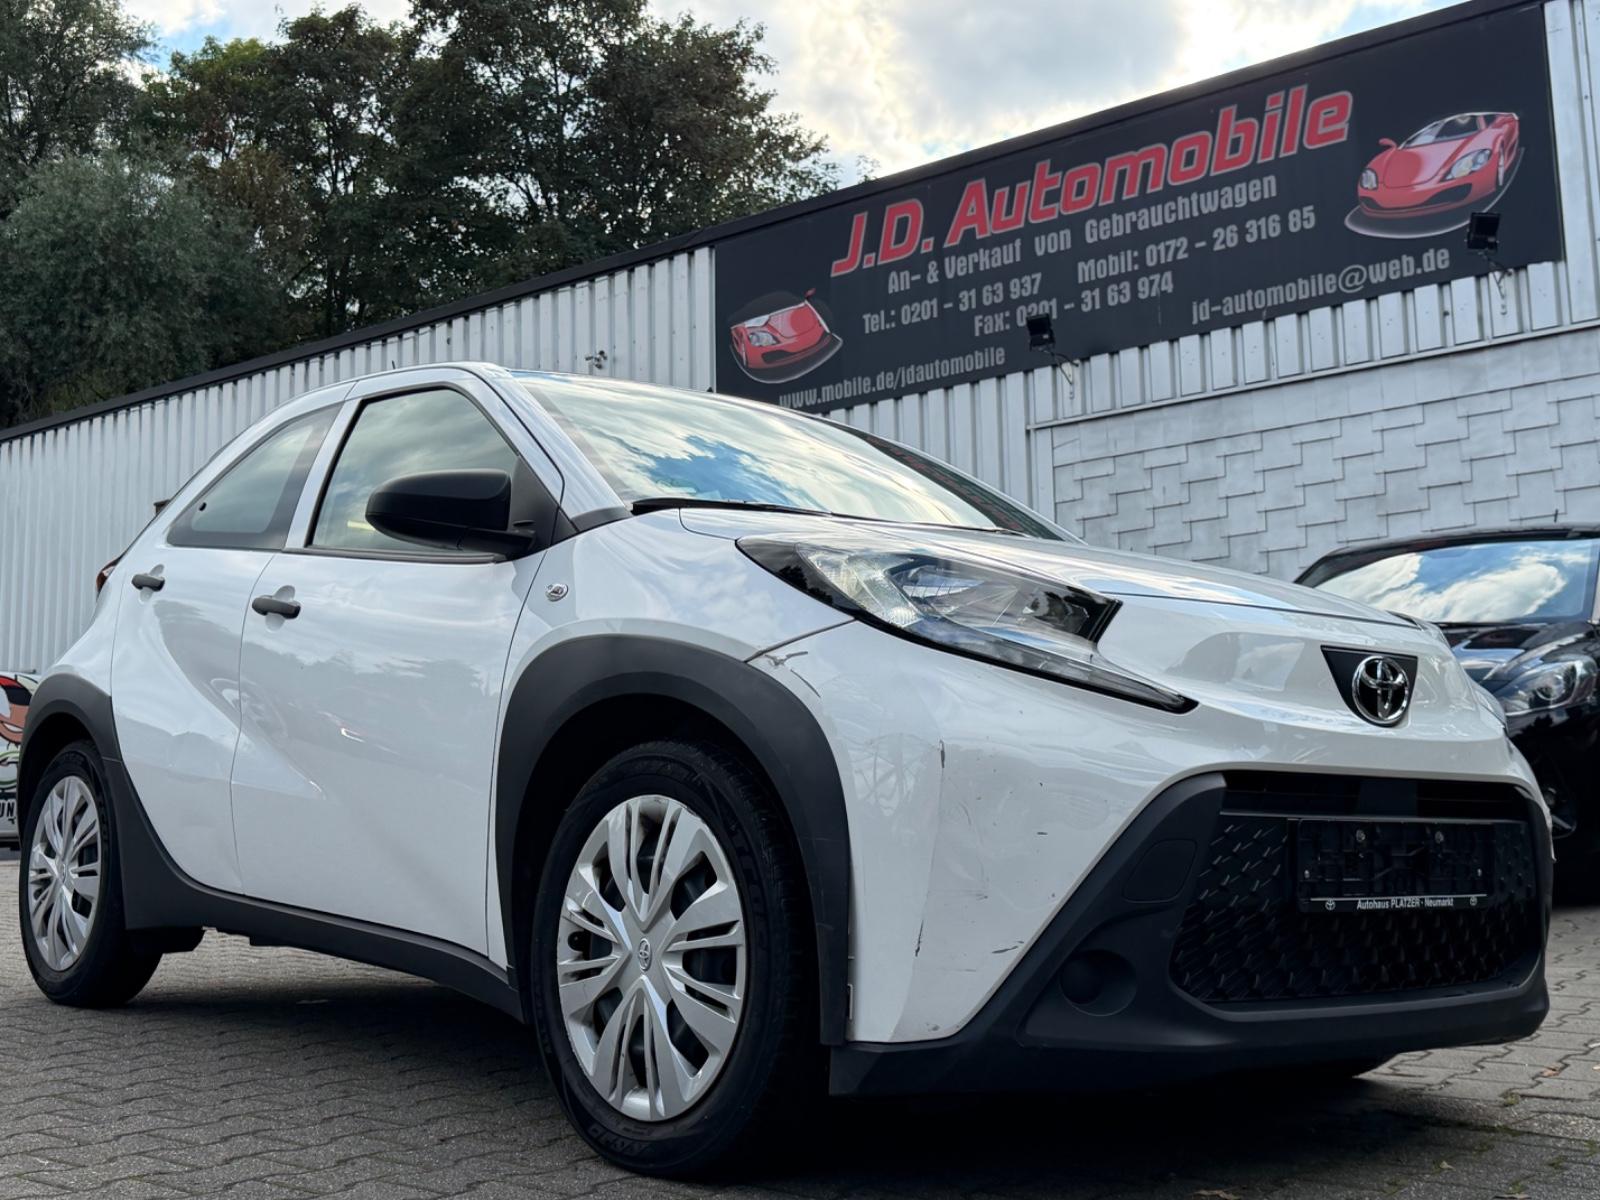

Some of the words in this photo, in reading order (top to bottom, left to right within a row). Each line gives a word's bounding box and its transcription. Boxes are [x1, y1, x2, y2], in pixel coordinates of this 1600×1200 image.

[830, 198, 935, 277] J.D.
[943, 84, 1354, 248] Automobile
[888, 269, 921, 294] An-
[926, 261, 939, 284] &
[944, 240, 1022, 280] Verkauf
[1033, 227, 1072, 257] von
[1084, 174, 1278, 243] Gebrauchtwagen
[1077, 249, 1140, 284] Mobil:
[1145, 236, 1189, 269] 0172
[1212, 224, 1239, 253] 26
[1245, 215, 1282, 246] 316
[1288, 205, 1317, 232] 85
[862, 308, 896, 335] Tel.:
[900, 297, 939, 326] 0201
[959, 287, 977, 312] 31
[982, 282, 1004, 307] 63
[1009, 272, 1042, 300] 937
[973, 309, 1010, 337] Fax:
[1081, 287, 1101, 313] 31
[1106, 280, 1131, 306] 63
[1137, 270, 1174, 300] 974
[1192, 248, 1451, 325] jd-automobile@web.de
[779, 346, 1006, 408] www.mobile.de/jdautomobile
[1357, 899, 1390, 910] Autohaus
[1391, 897, 1421, 909] PLATZER
[1424, 897, 1454, 908] Neumarkt
